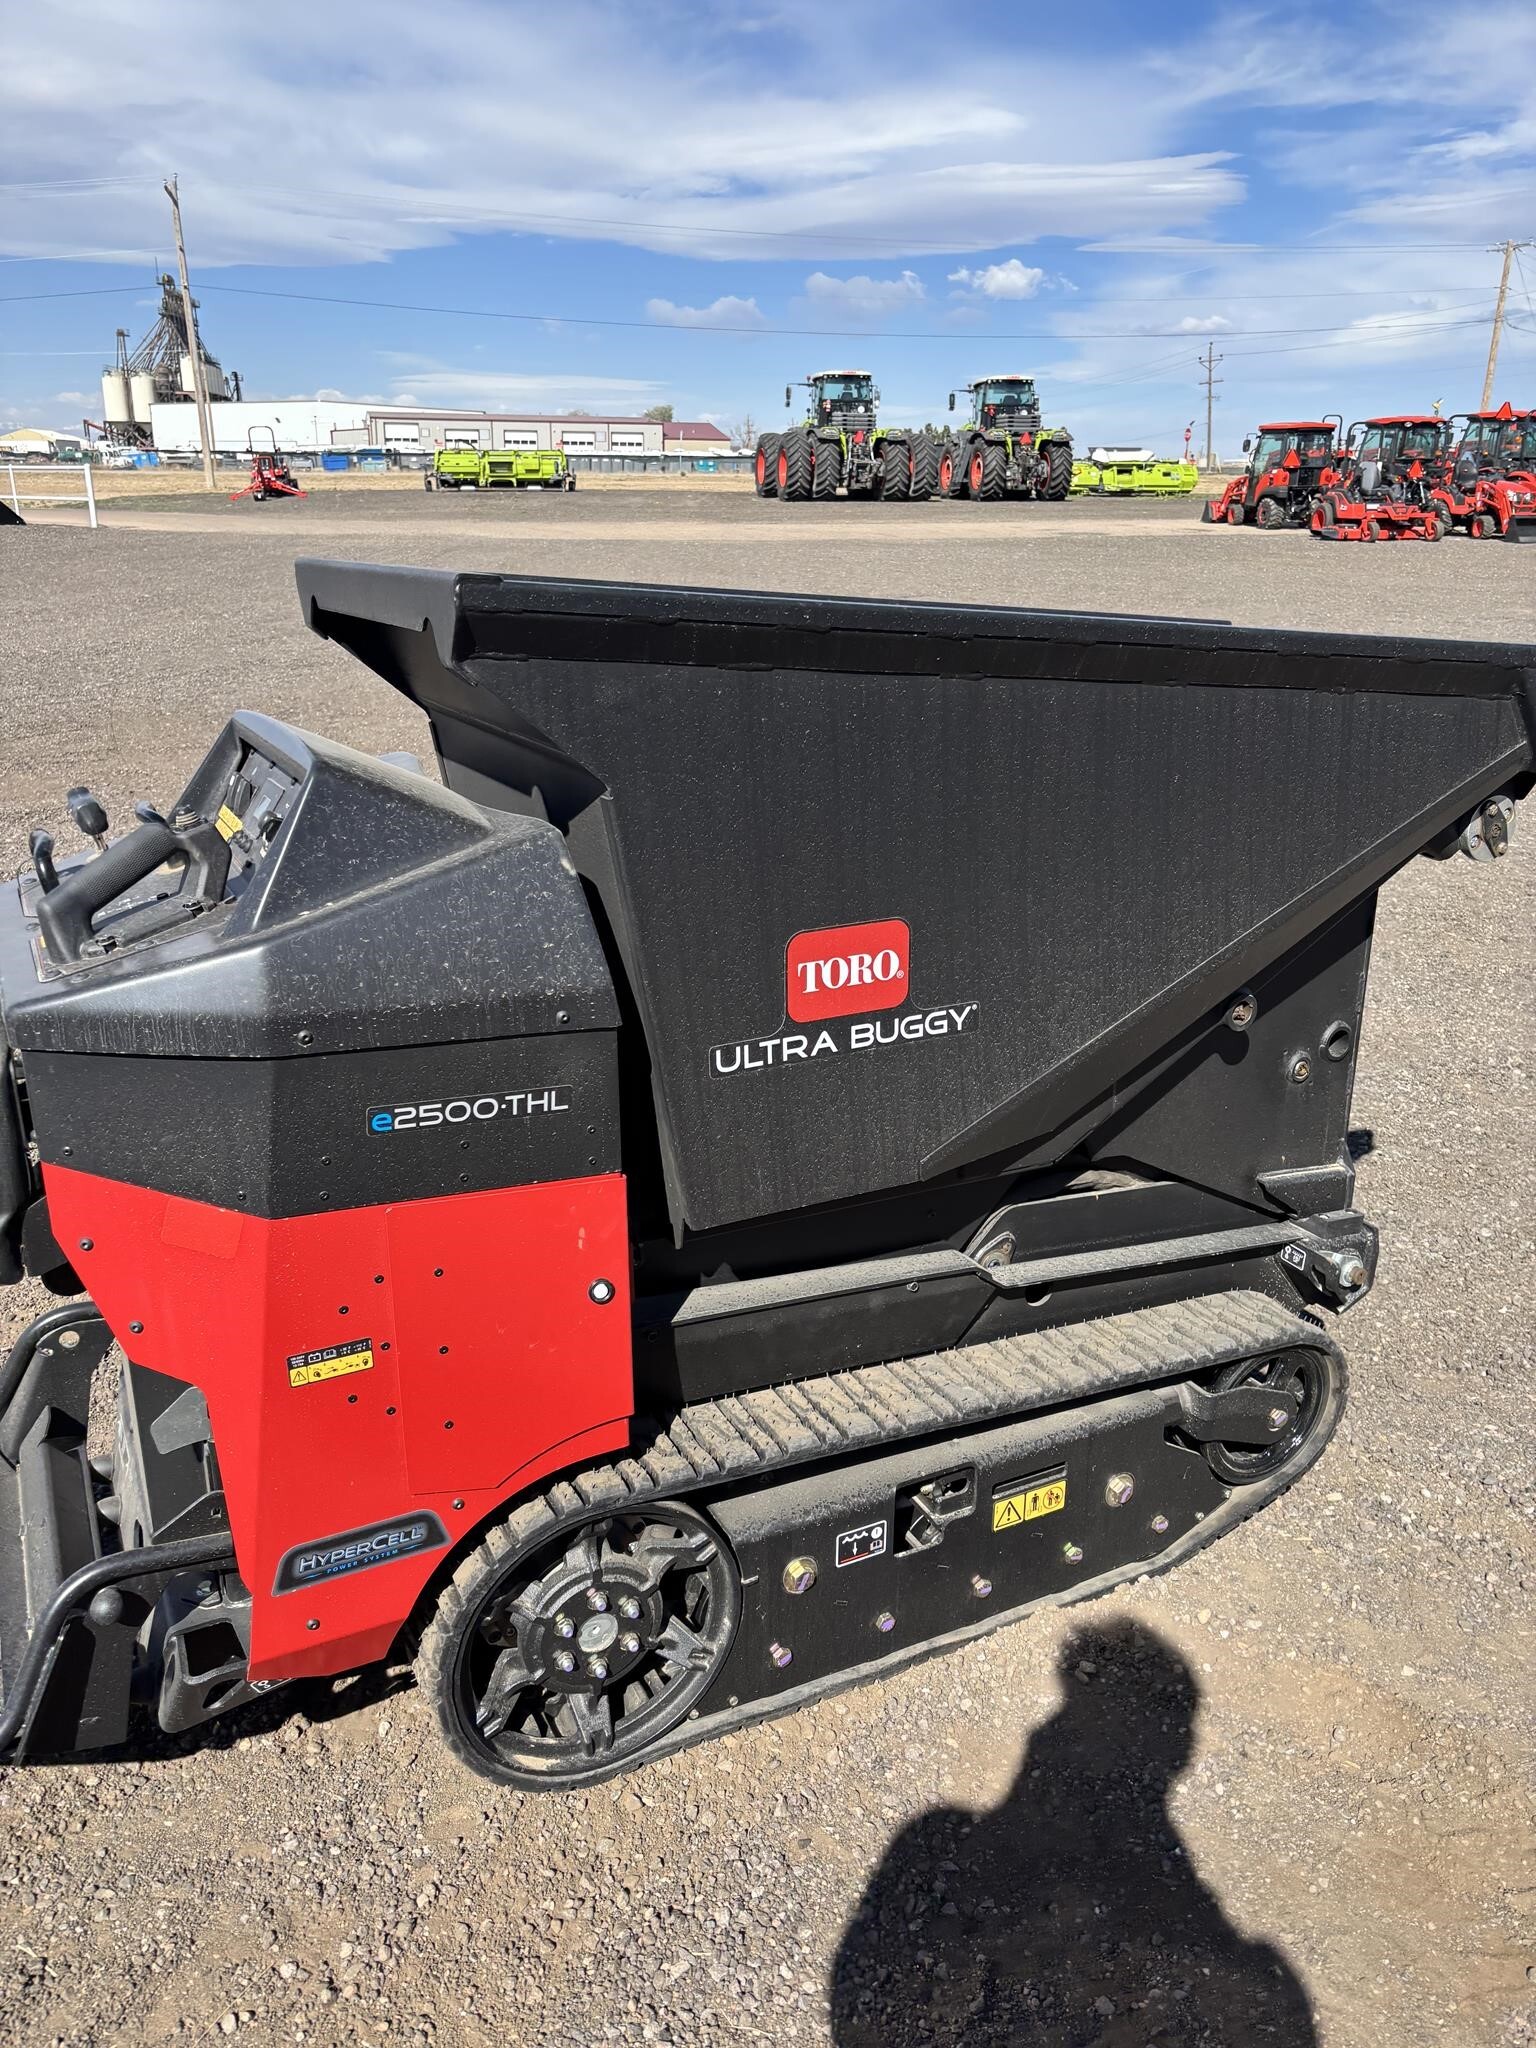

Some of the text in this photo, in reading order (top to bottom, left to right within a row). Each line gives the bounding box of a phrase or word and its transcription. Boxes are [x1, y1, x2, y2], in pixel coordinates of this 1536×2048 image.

[715, 1030, 838, 1073] ULTRA
[326, 1549, 399, 1574] POWER SYSTEM
